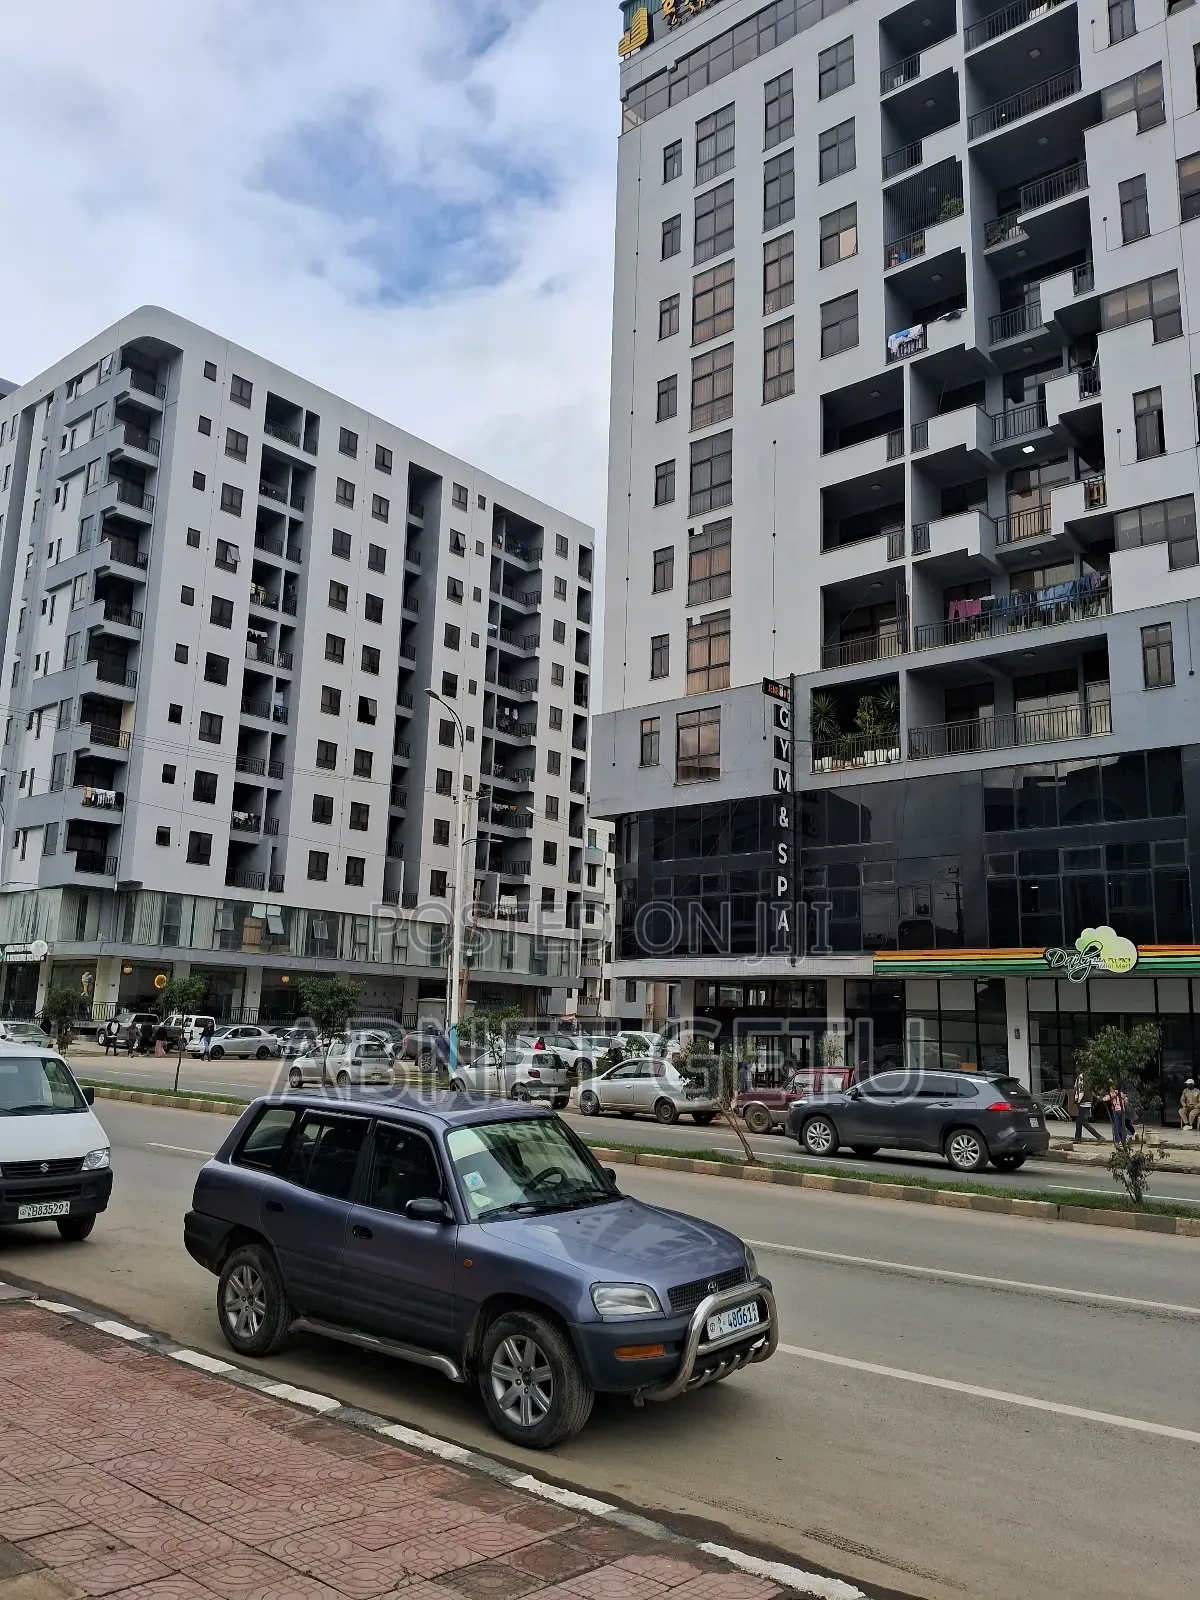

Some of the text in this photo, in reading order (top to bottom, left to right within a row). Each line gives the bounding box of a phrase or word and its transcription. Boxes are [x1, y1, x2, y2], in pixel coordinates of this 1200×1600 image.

[778, 706, 790, 790] GYM
[777, 842, 790, 932] SPA
[1045, 940, 1103, 984] Daily
